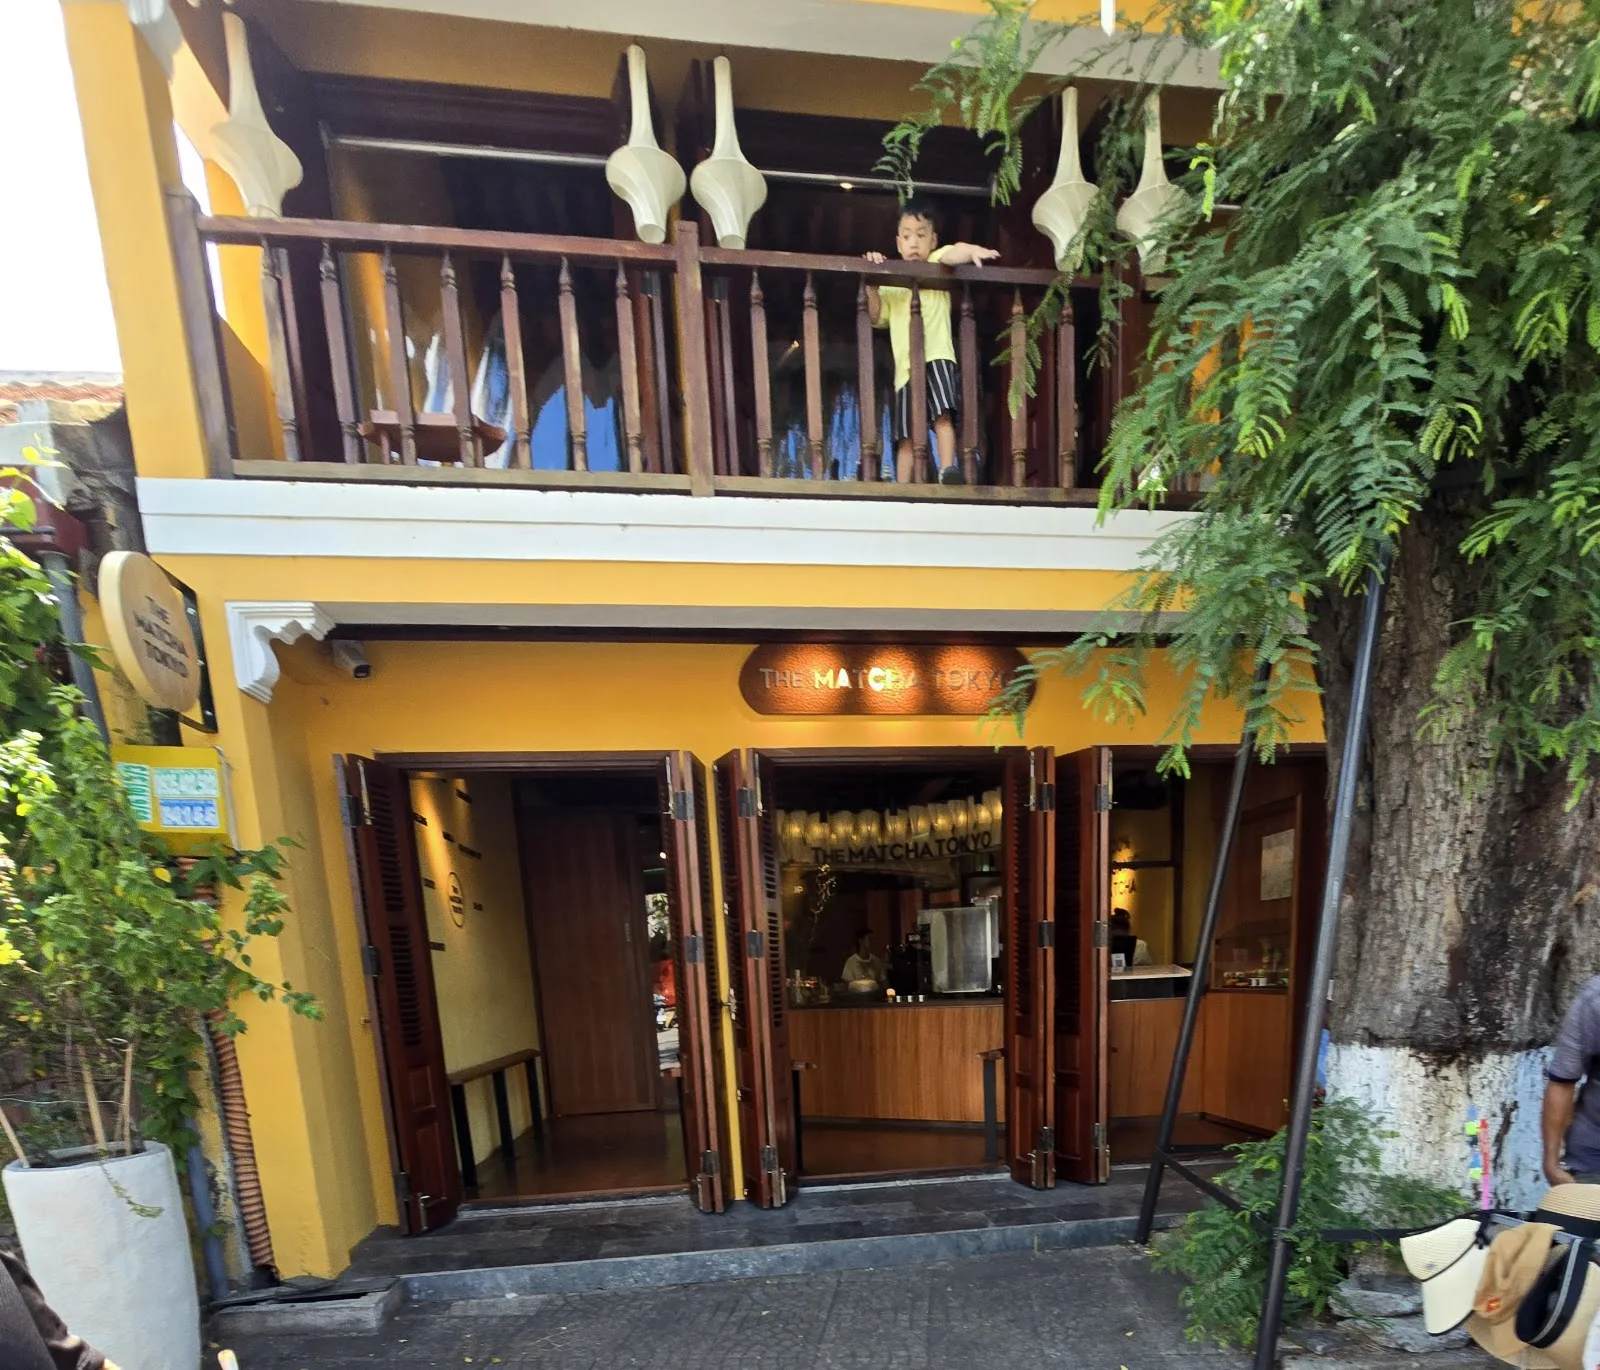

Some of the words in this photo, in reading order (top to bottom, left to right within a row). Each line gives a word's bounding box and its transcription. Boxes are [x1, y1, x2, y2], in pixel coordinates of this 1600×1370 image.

[759, 667, 802, 689] THE
[811, 847, 845, 864] THE
[851, 841, 932, 862] MATCHA
[935, 831, 992, 852] TOKYO
